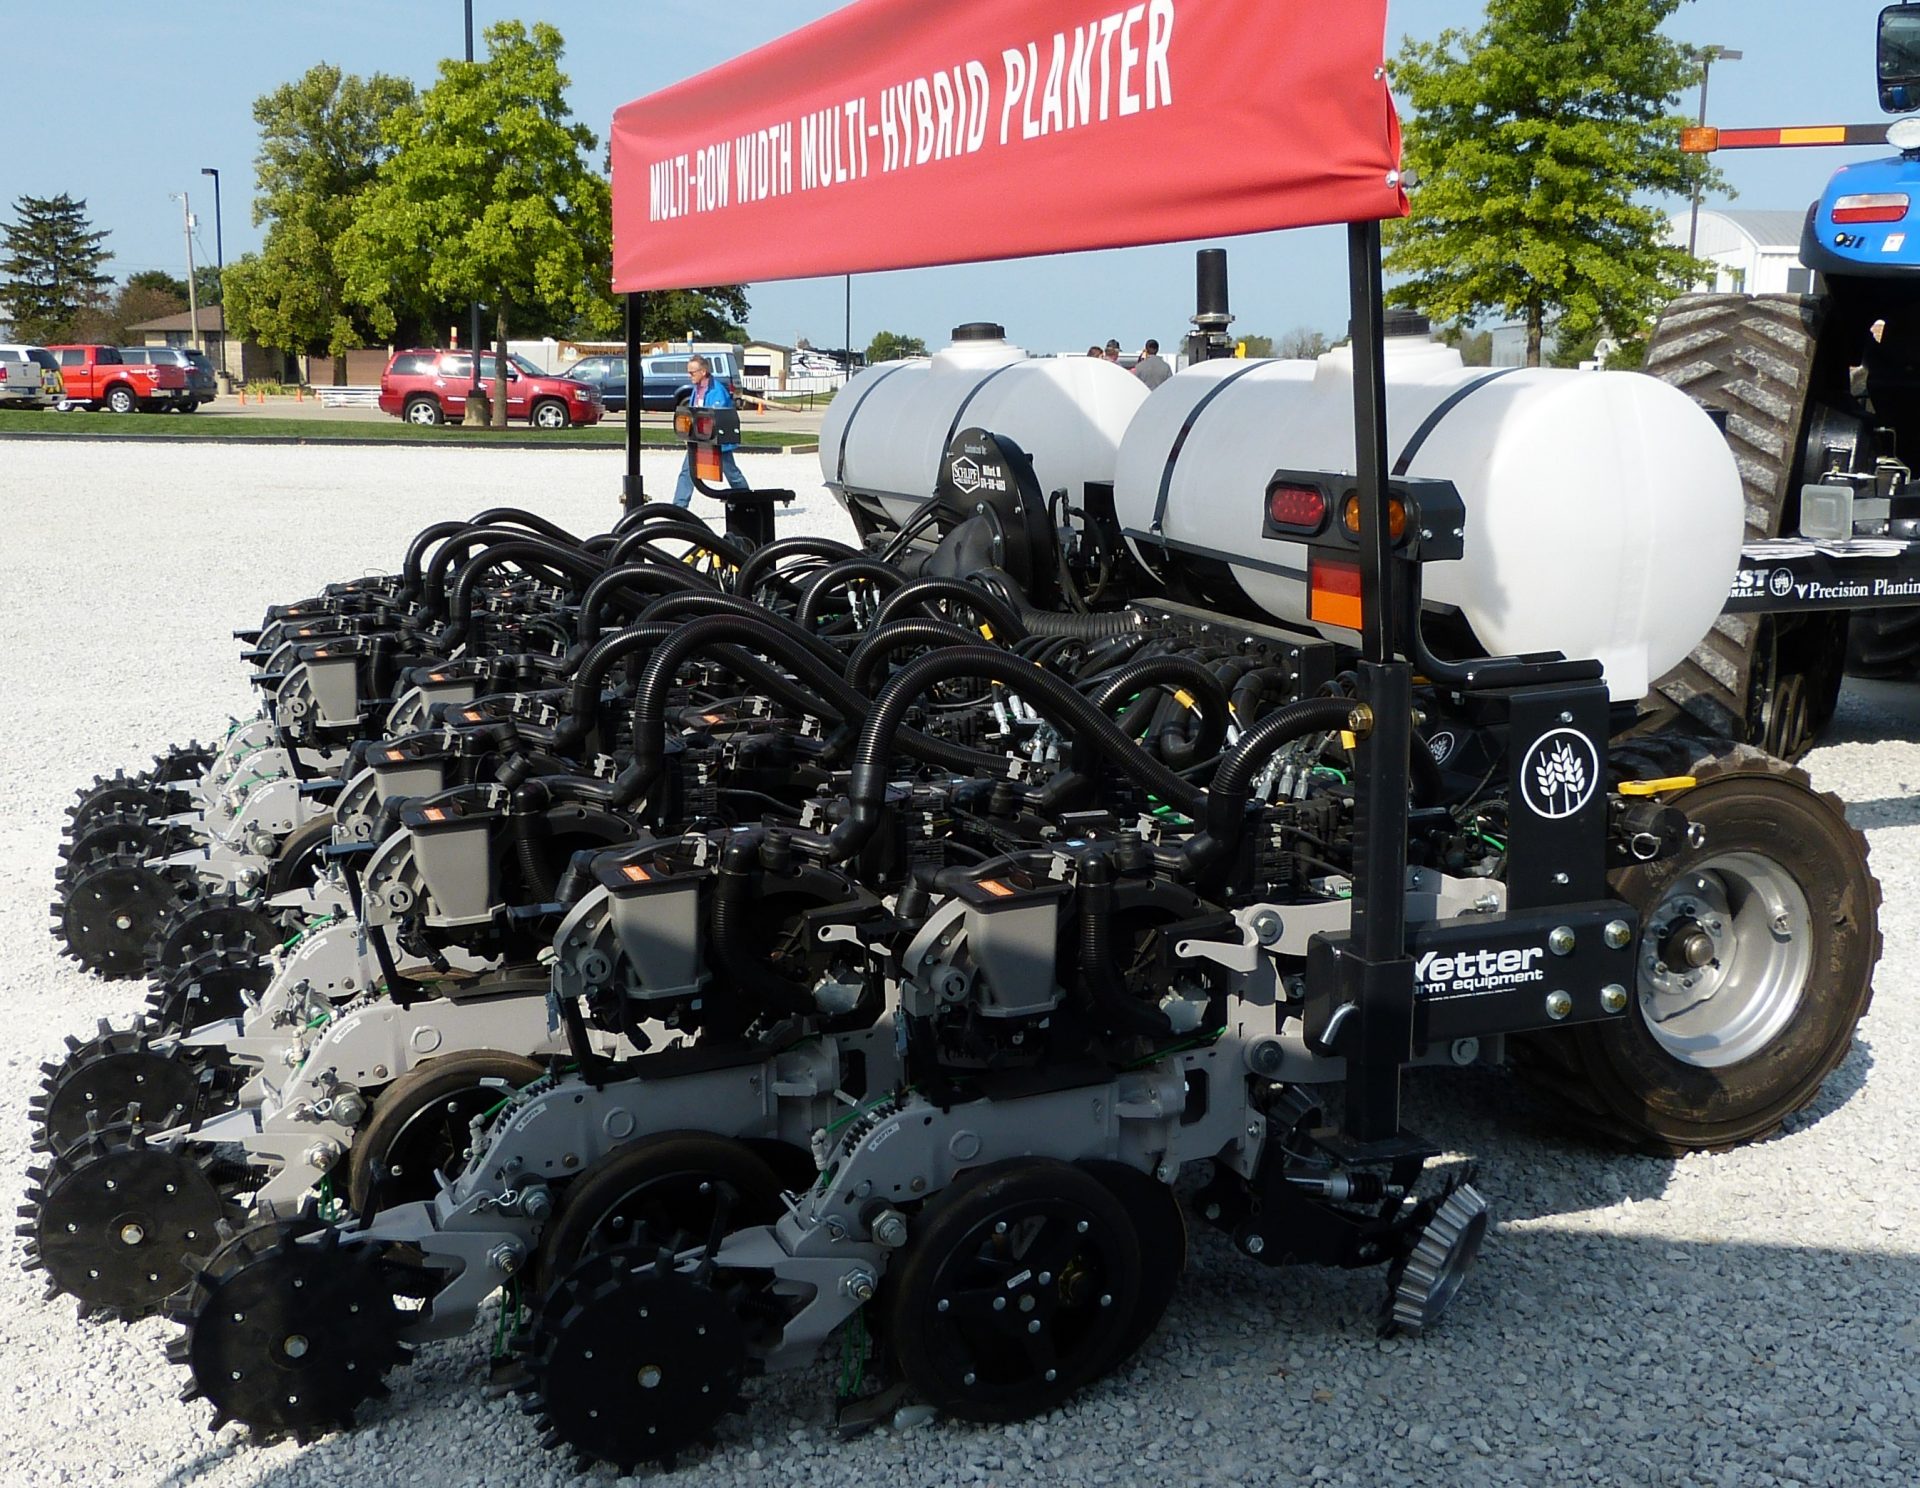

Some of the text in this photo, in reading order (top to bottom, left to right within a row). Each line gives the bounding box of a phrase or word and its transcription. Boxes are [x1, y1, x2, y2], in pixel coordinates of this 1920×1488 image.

[649, 0, 1175, 222] MULTI-ROW WIDTH MULTI-HYBRID PLANTER
[1732, 570, 1769, 587] EST
[1809, 578, 1920, 599] Precision Plantin
[1728, 588, 1753, 597] NAL
[1415, 947, 1543, 982] Yetter
[1413, 982, 1446, 995] arm
[1452, 969, 1544, 991] equipment
